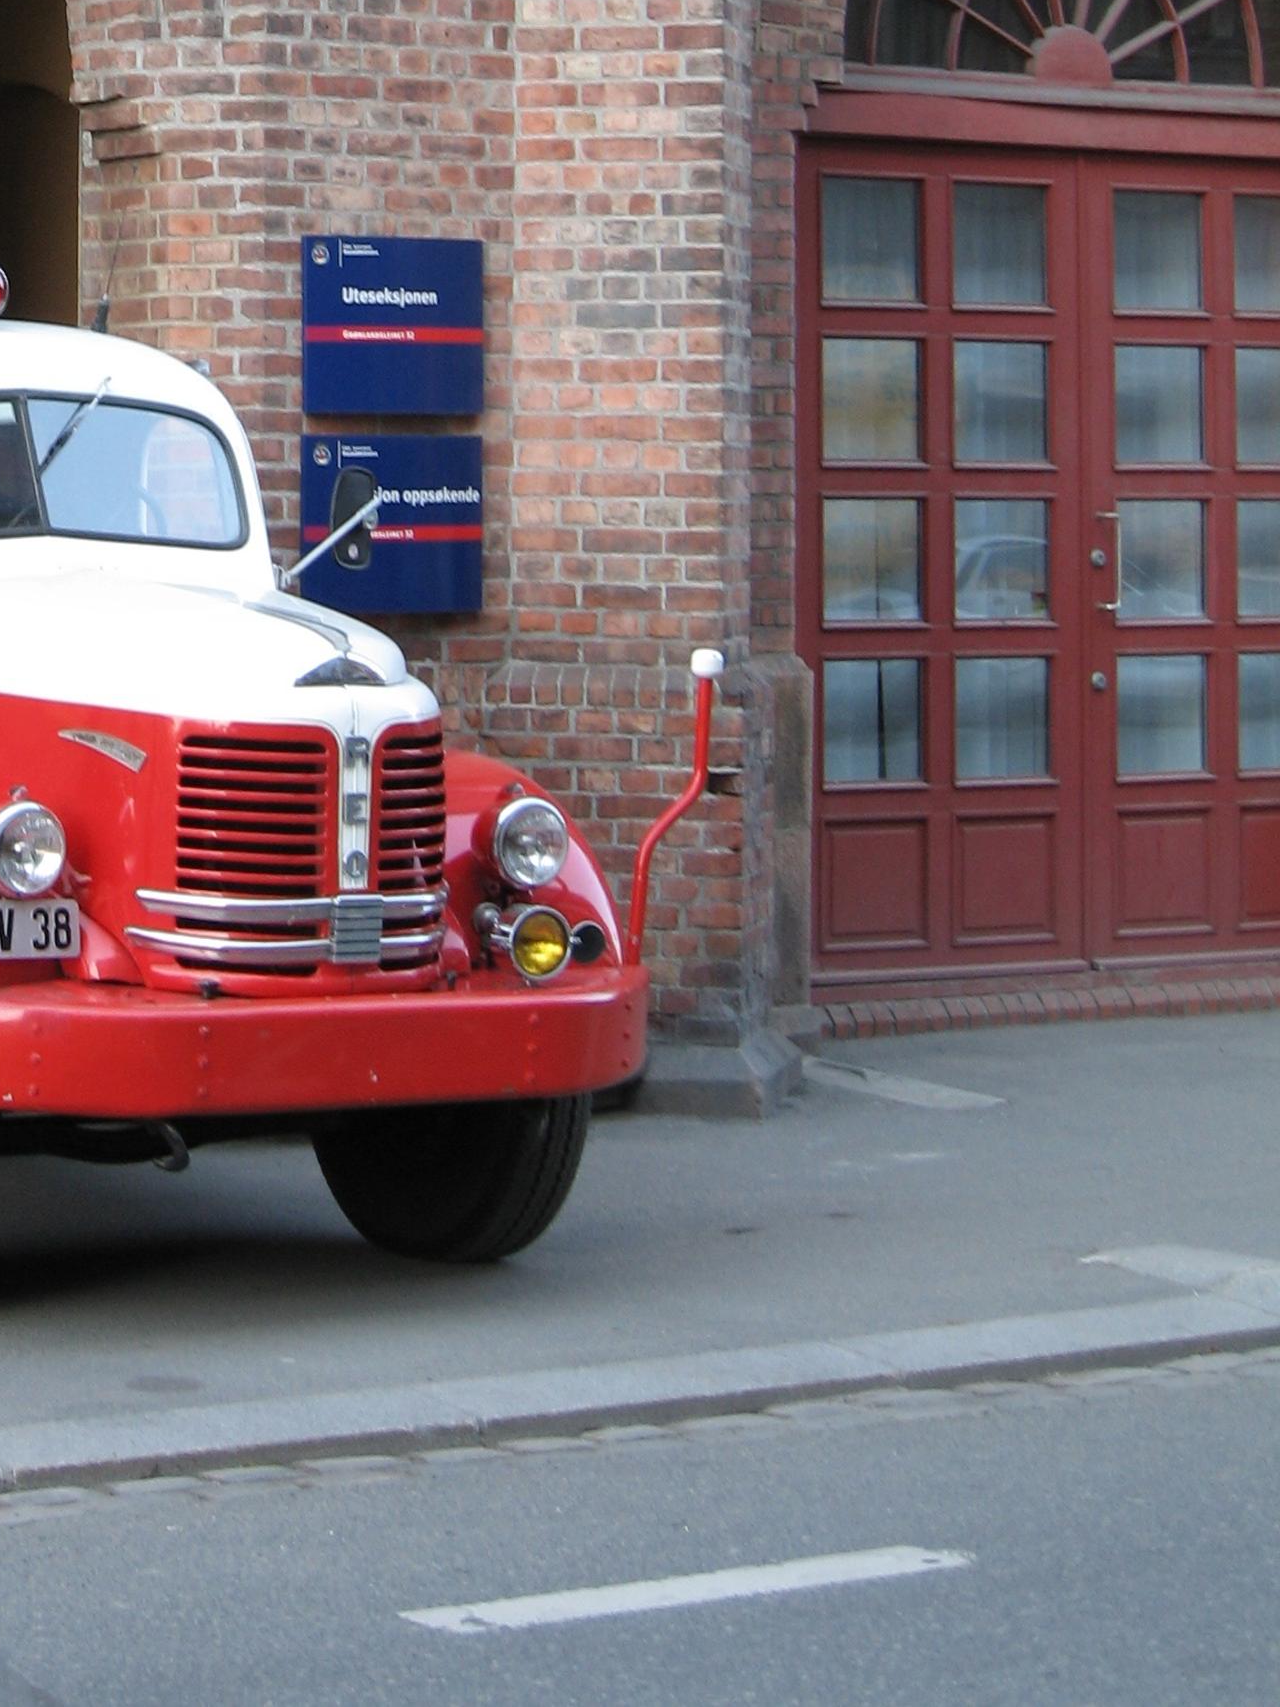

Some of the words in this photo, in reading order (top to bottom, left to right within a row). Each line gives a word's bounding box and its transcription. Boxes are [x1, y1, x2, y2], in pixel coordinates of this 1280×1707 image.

[342, 287, 438, 308] Uteseksjonen
[402, 485, 480, 507] oppsøkende
[31, 906, 73, 950] 38
